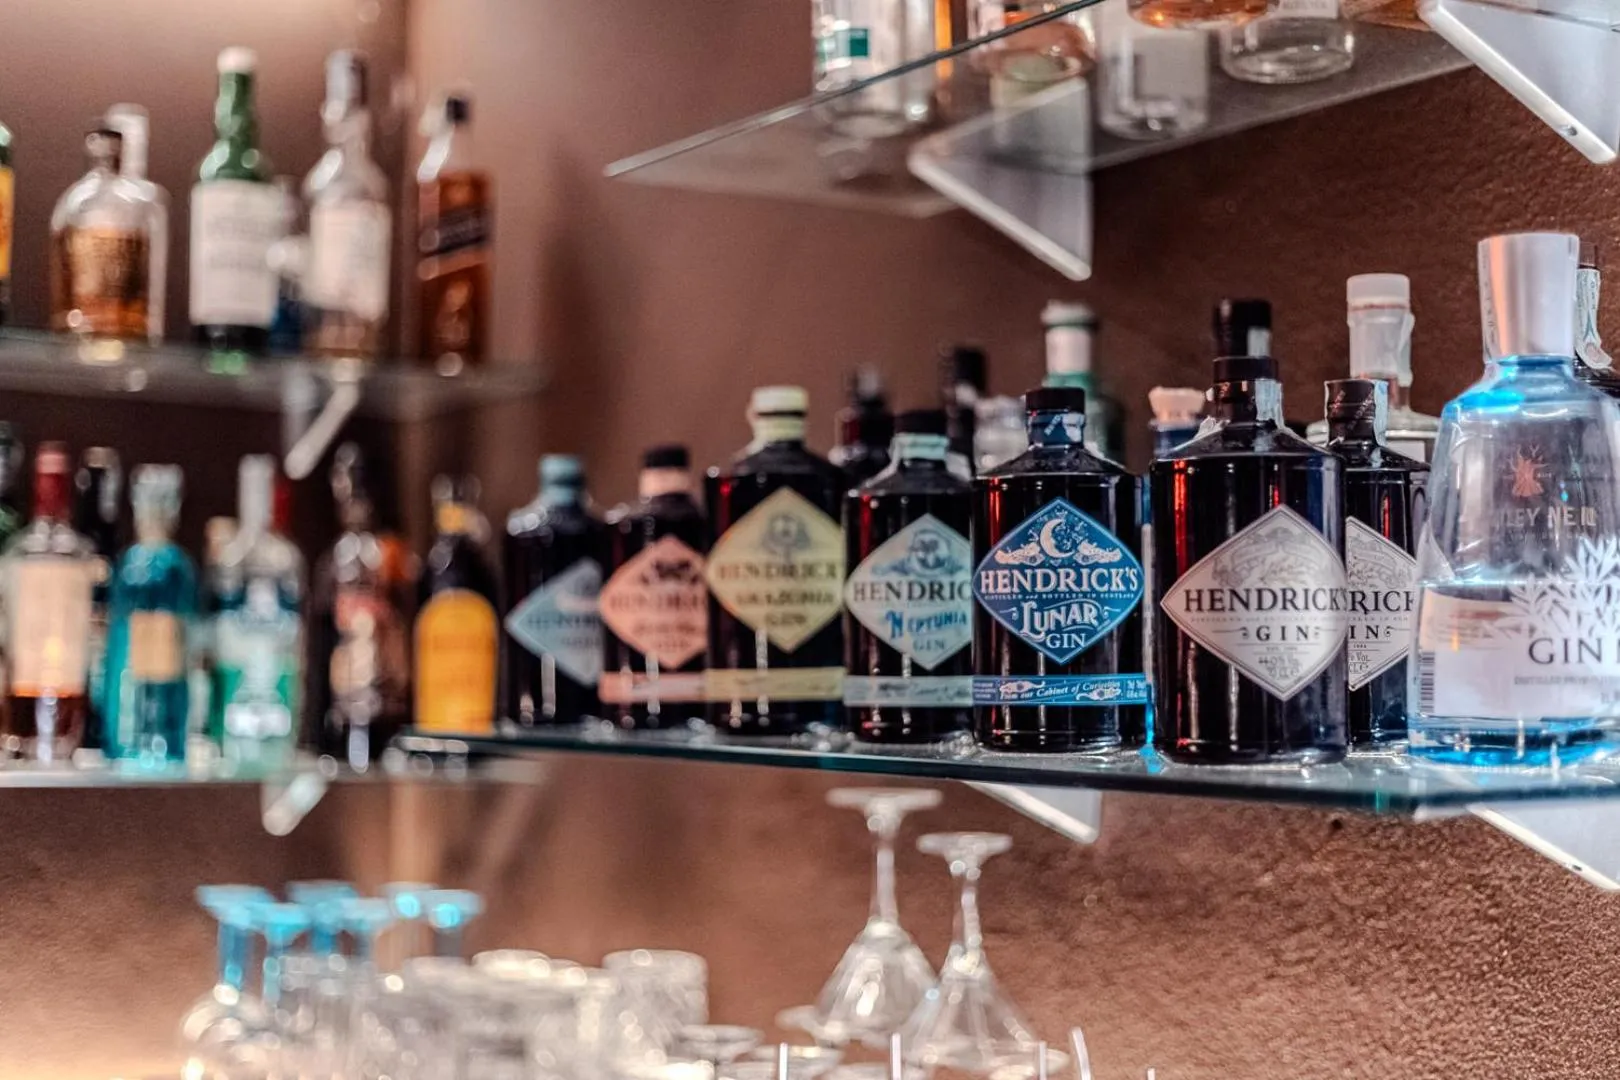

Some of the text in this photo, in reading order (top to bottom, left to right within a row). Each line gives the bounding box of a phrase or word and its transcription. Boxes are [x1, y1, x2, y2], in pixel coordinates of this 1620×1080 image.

[980, 567, 1139, 594] HENDRICK'S
[1019, 600, 1098, 642] LUNAR
[1045, 633, 1087, 648] GIN
[1256, 625, 1309, 641] GIN
[913, 638, 945, 651] GIN
[1528, 636, 1602, 665] GIN
[1036, 686, 1068, 697] Cabinet
